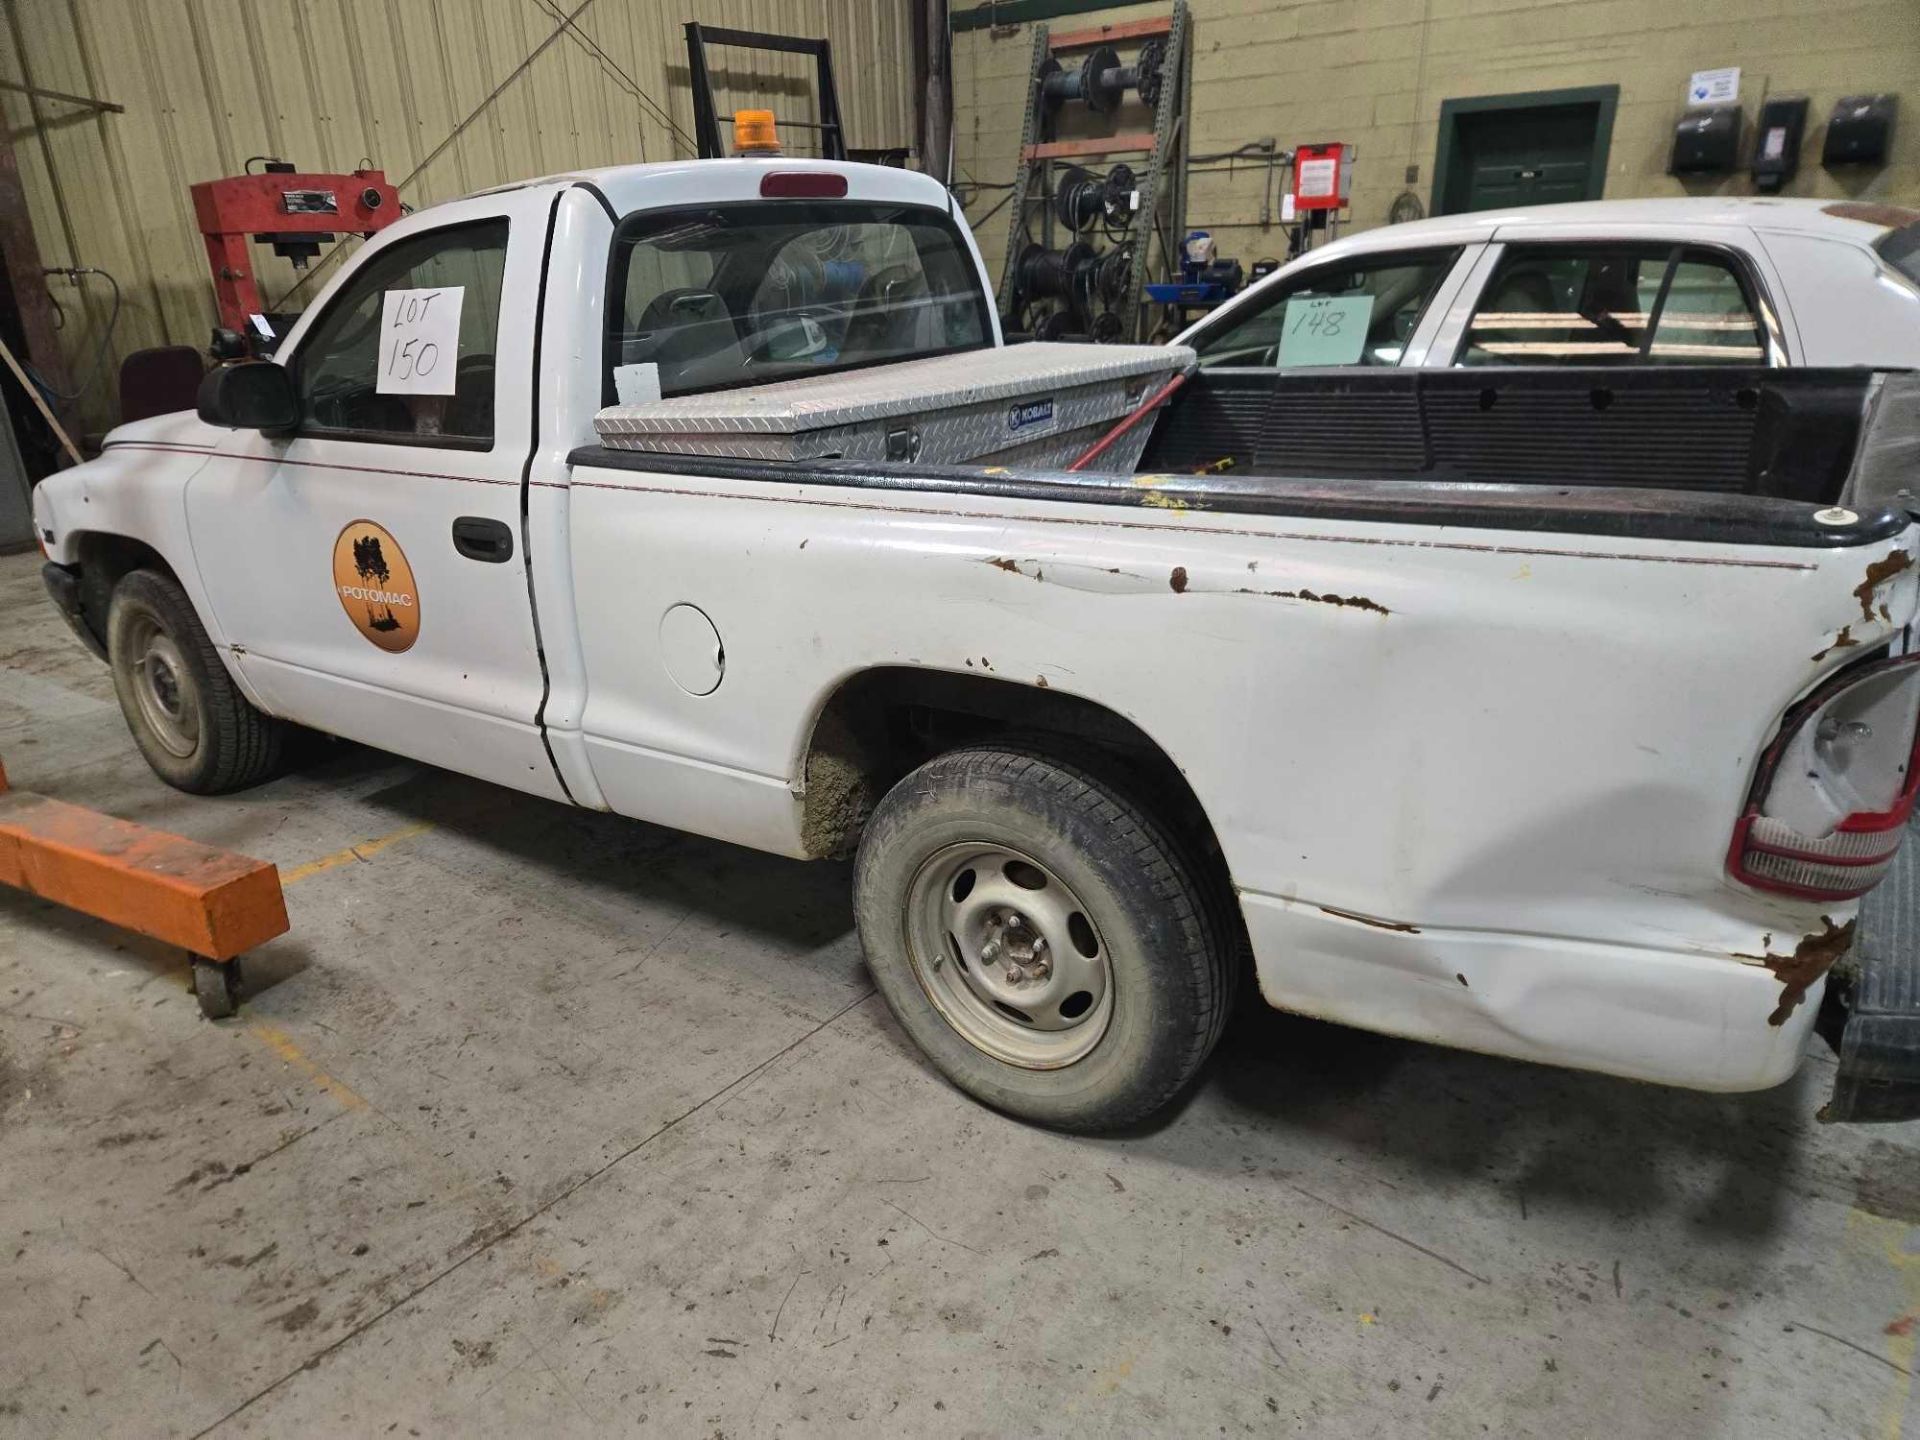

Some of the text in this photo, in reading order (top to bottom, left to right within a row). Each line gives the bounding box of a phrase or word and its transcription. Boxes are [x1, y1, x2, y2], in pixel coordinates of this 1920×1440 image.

[393, 293, 442, 328] LOT
[1291, 311, 1346, 336] 148
[388, 338, 439, 380] 150
[1021, 402, 1052, 421] KOBALT
[342, 585, 413, 607] POTOMAC
